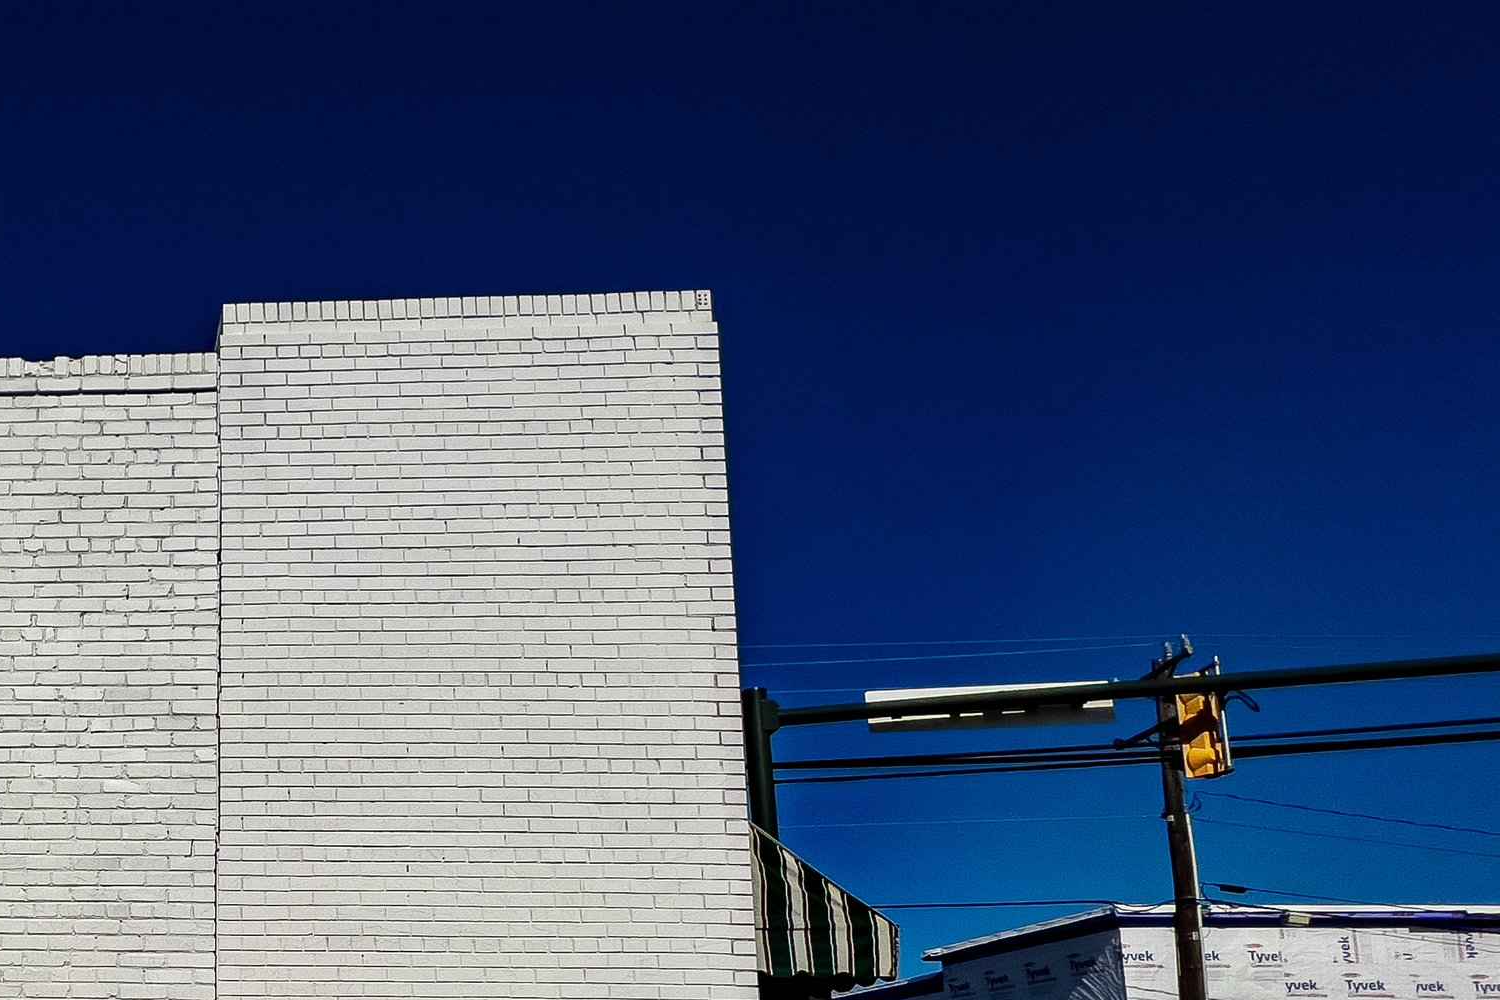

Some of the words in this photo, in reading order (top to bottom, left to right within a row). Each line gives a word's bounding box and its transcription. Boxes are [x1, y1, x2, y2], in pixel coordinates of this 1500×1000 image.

[1122, 950, 1154, 963] yvek
[1285, 980, 1317, 992] yvek
[1345, 979, 1386, 993] Tyvek
